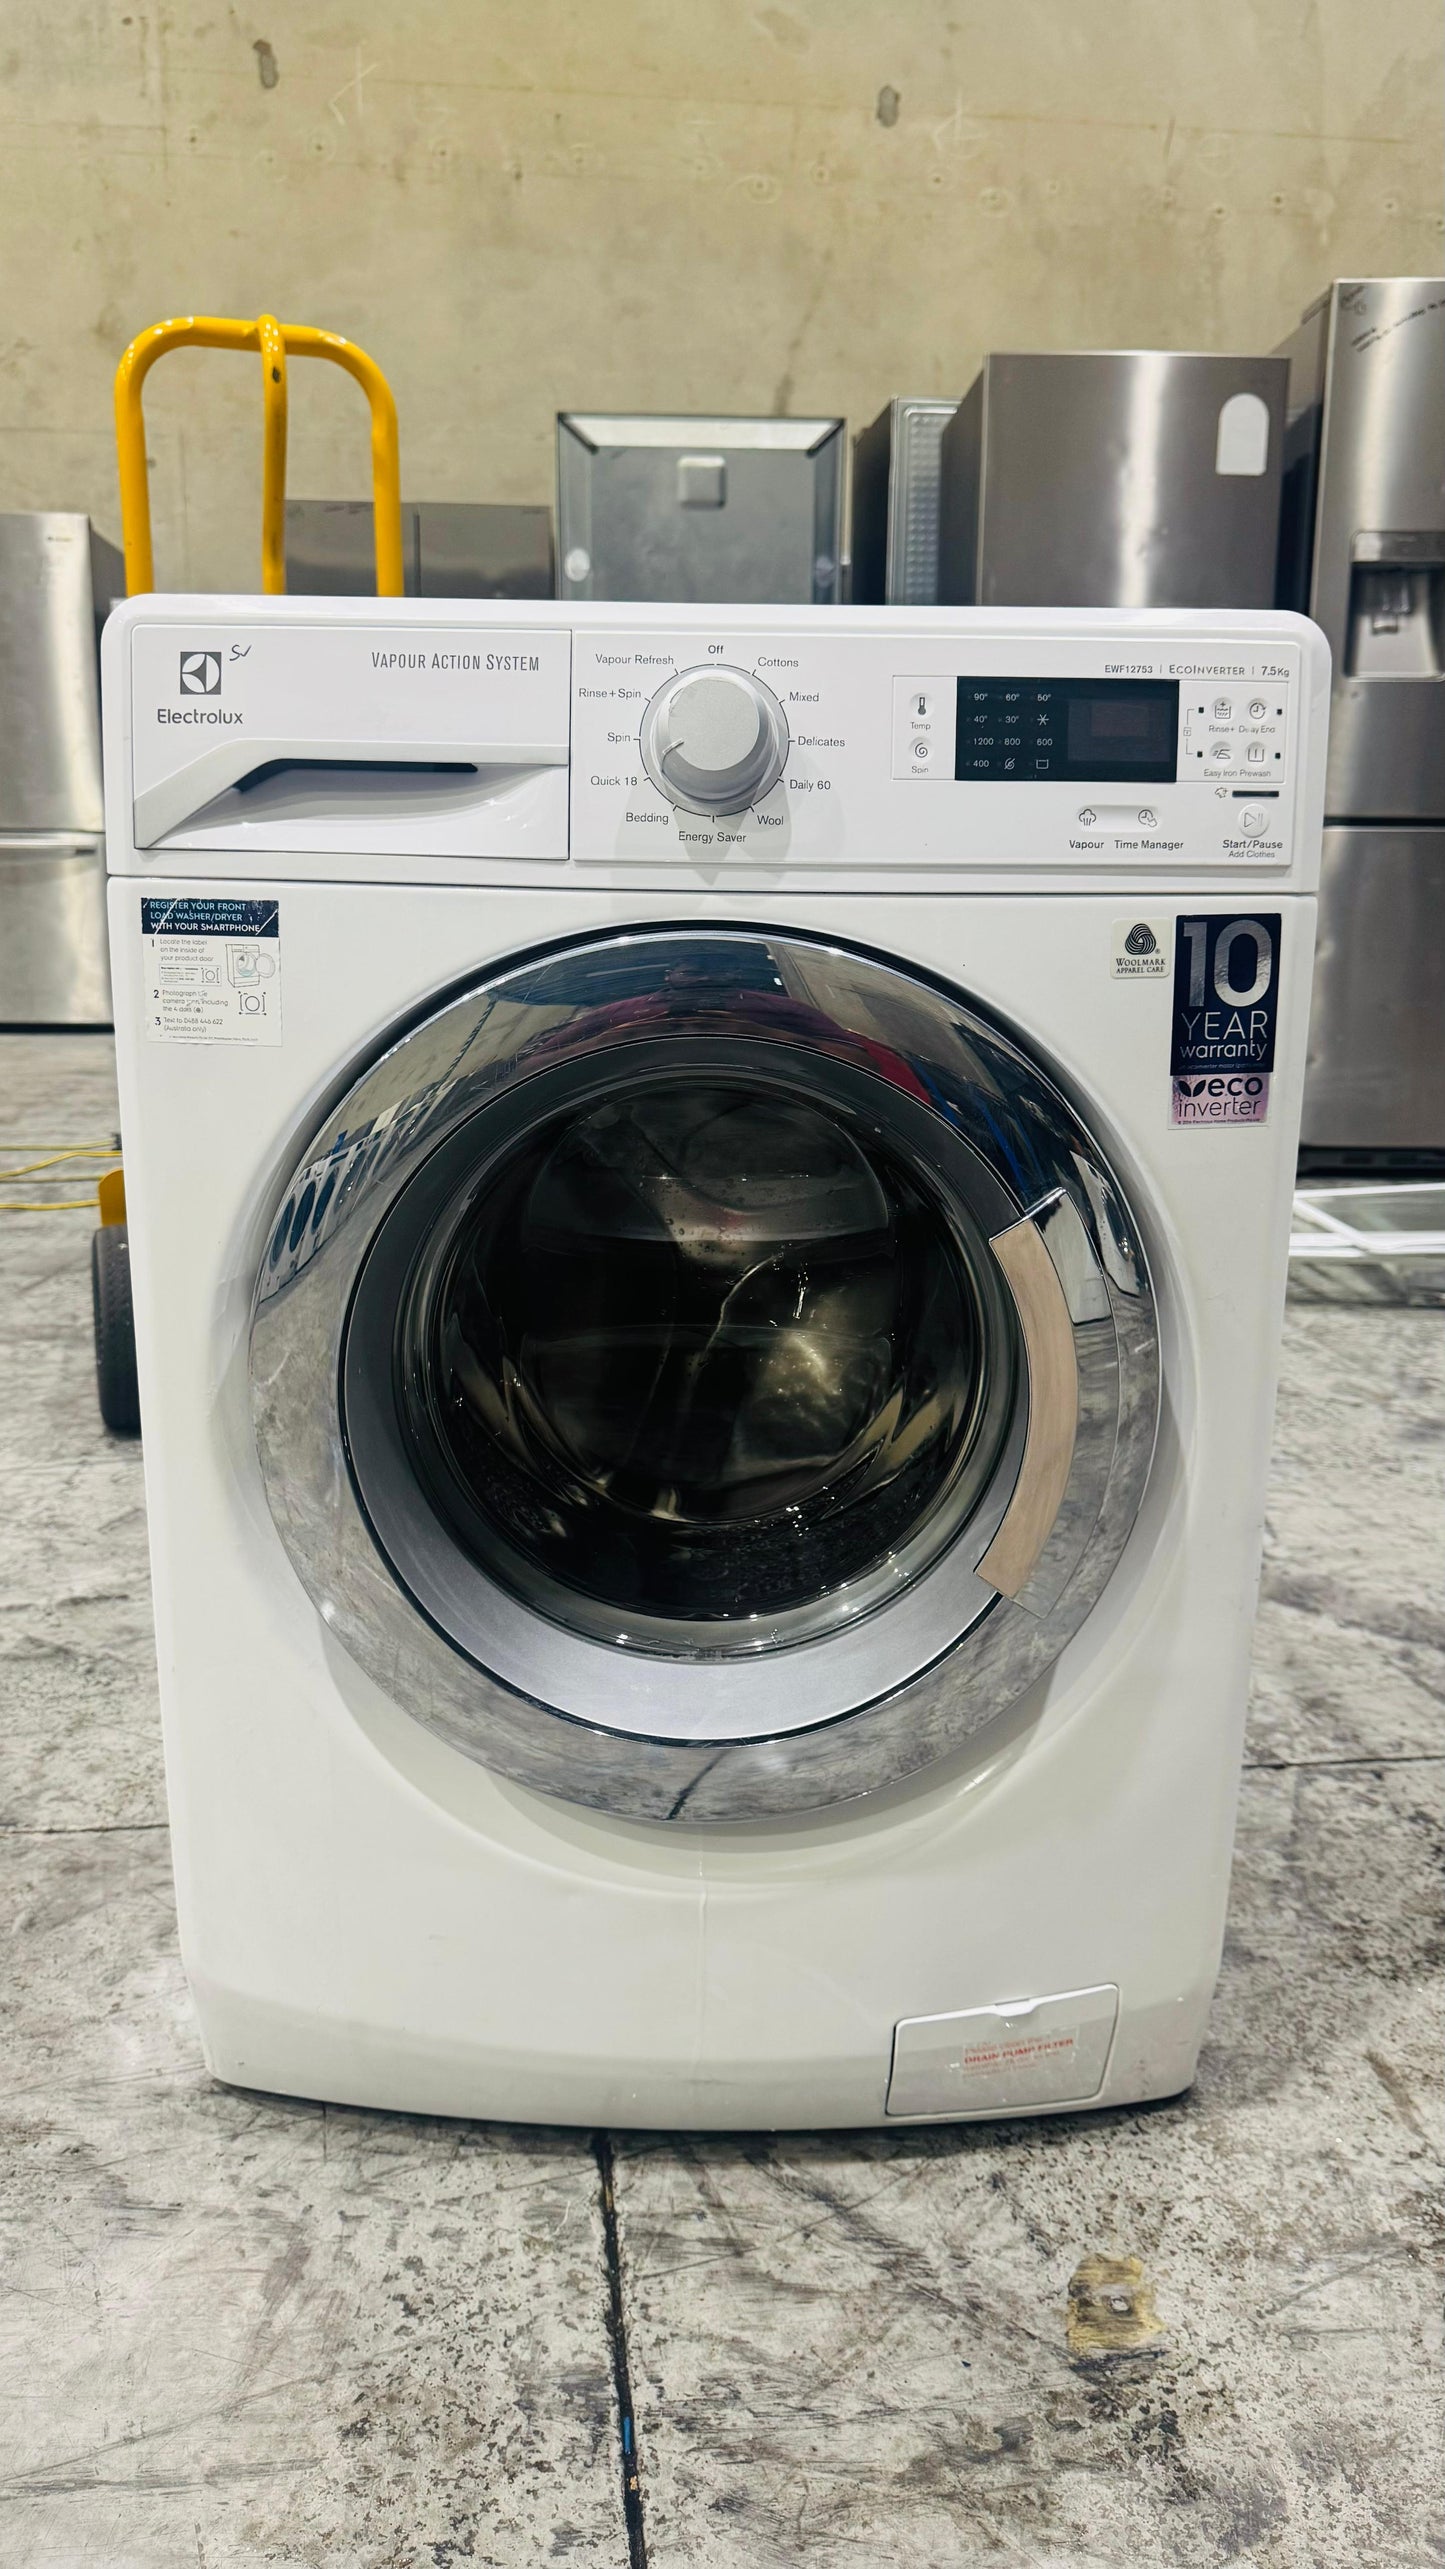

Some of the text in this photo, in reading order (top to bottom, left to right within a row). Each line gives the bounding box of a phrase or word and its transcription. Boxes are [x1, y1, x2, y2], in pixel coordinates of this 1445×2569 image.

[707, 644, 724, 655] Off
[371, 651, 540, 672] VAPOUR ACTION SYSTEM
[595, 654, 674, 666] Vapour Refresh
[757, 657, 799, 668] Cottons
[1104, 664, 1153, 674] EWF12753
[1261, 665, 1290, 678] 7.5Kg
[789, 691, 820, 703] Mixed
[157, 707, 243, 725] Electrolux
[909, 722, 931, 732] Temp
[607, 732, 631, 743] Spin
[797, 735, 846, 747] Delicates
[973, 738, 1053, 746] 1200 800 600
[972, 760, 990, 768] 400
[911, 765, 929, 775] Spin
[1203, 769, 1272, 779] Easy Iron Prewash
[590, 775, 638, 787] Quick 18
[789, 779, 832, 792] Daily 60
[625, 812, 669, 825] Bedding
[757, 815, 784, 826] Wool
[678, 831, 747, 844] Energy Saver
[1069, 840, 1184, 852] Vapour Time Manager
[1222, 840, 1284, 850] Start/Pause
[1228, 850, 1276, 859] Add Clothes
[150, 901, 247, 911] REGISTER YOUR FRONT
[150, 911, 243, 922] LOAD WASHER/DRYER
[150, 921, 261, 932] WITH YOUR SMARTPHONE
[1115, 957, 1166, 967] WOOLMARK
[1183, 919, 1273, 1008] 10
[1116, 966, 1165, 974] APPAREL CARE
[153, 989, 160, 999] 2
[155, 1016, 162, 1026] 3
[1180, 1010, 1268, 1041] YEAR
[1179, 1039, 1268, 1062] warranty
[1207, 1076, 1264, 1098] eco
[1178, 1096, 1262, 1118] inverter
